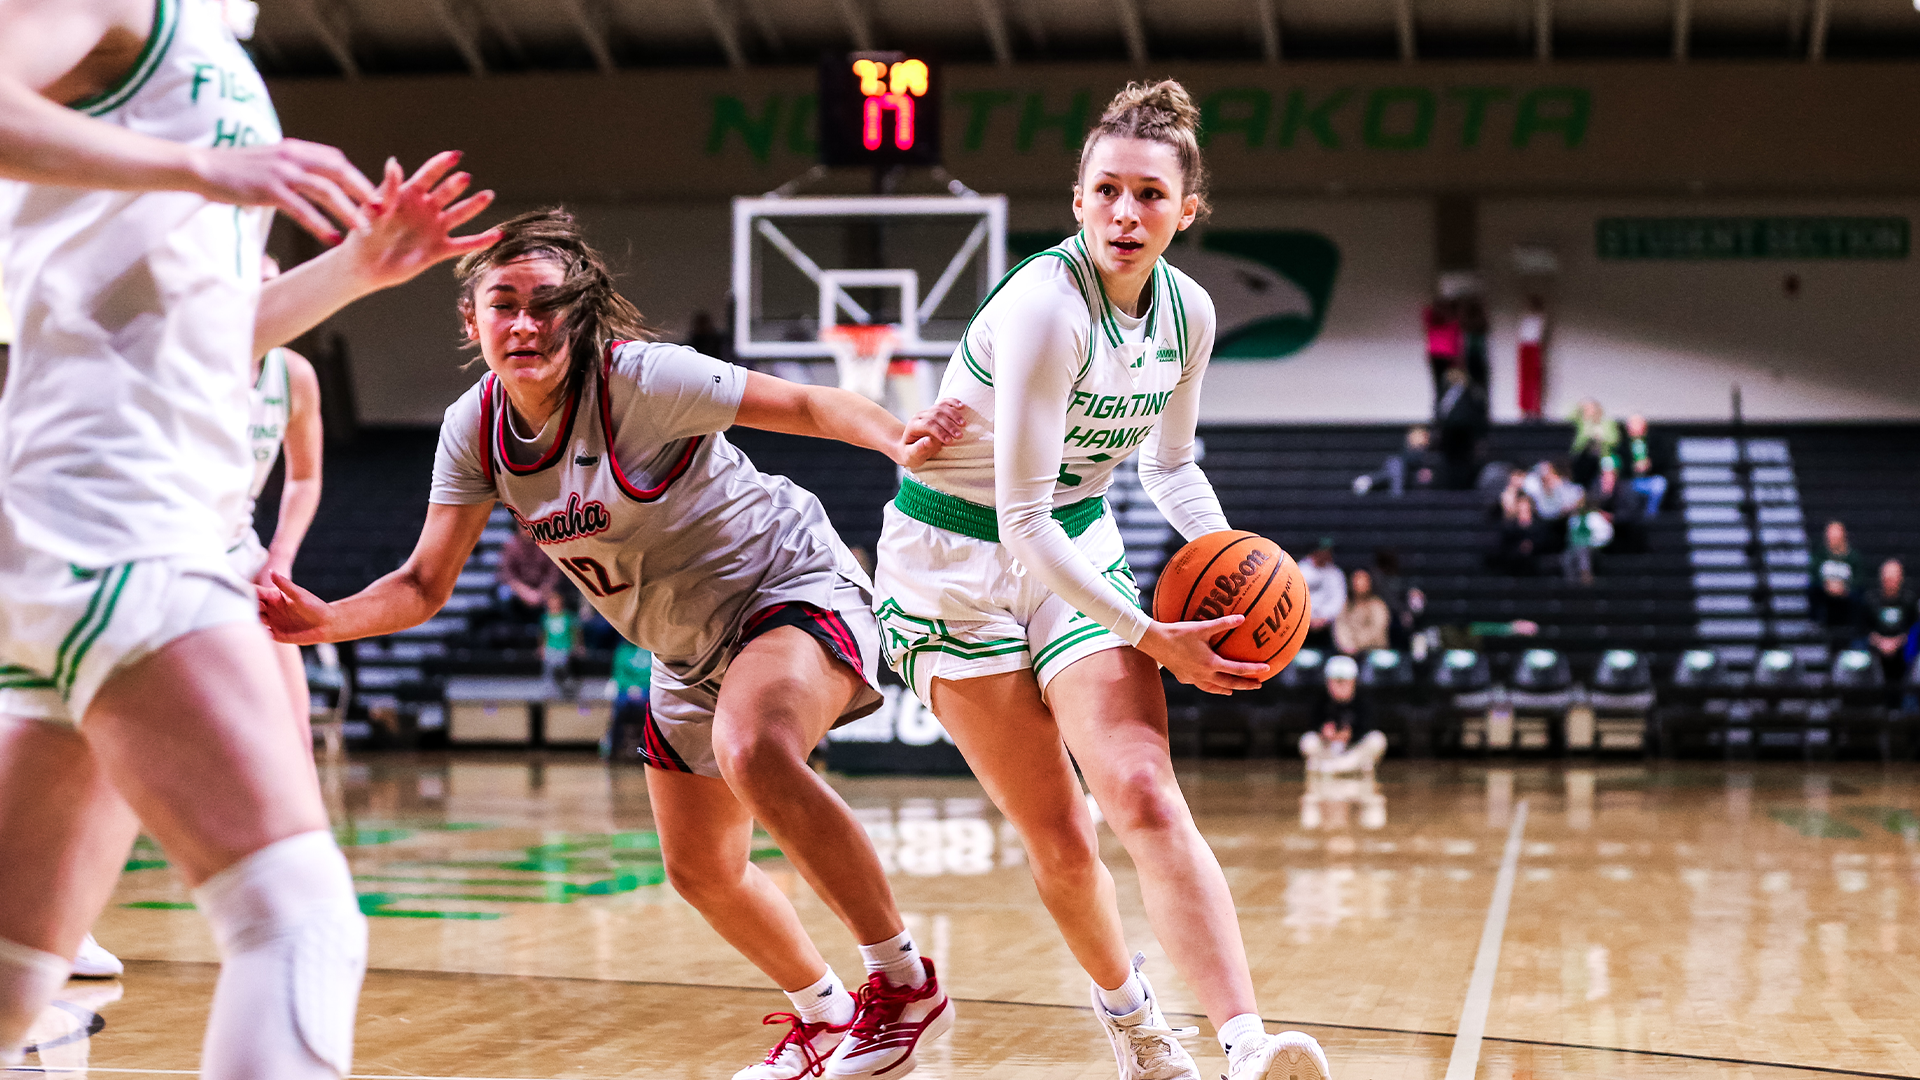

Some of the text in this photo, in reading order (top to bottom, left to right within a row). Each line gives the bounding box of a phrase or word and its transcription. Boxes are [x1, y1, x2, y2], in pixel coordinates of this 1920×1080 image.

[706, 86, 1592, 160] NTH AKOTA
[558, 557, 634, 597] 12
